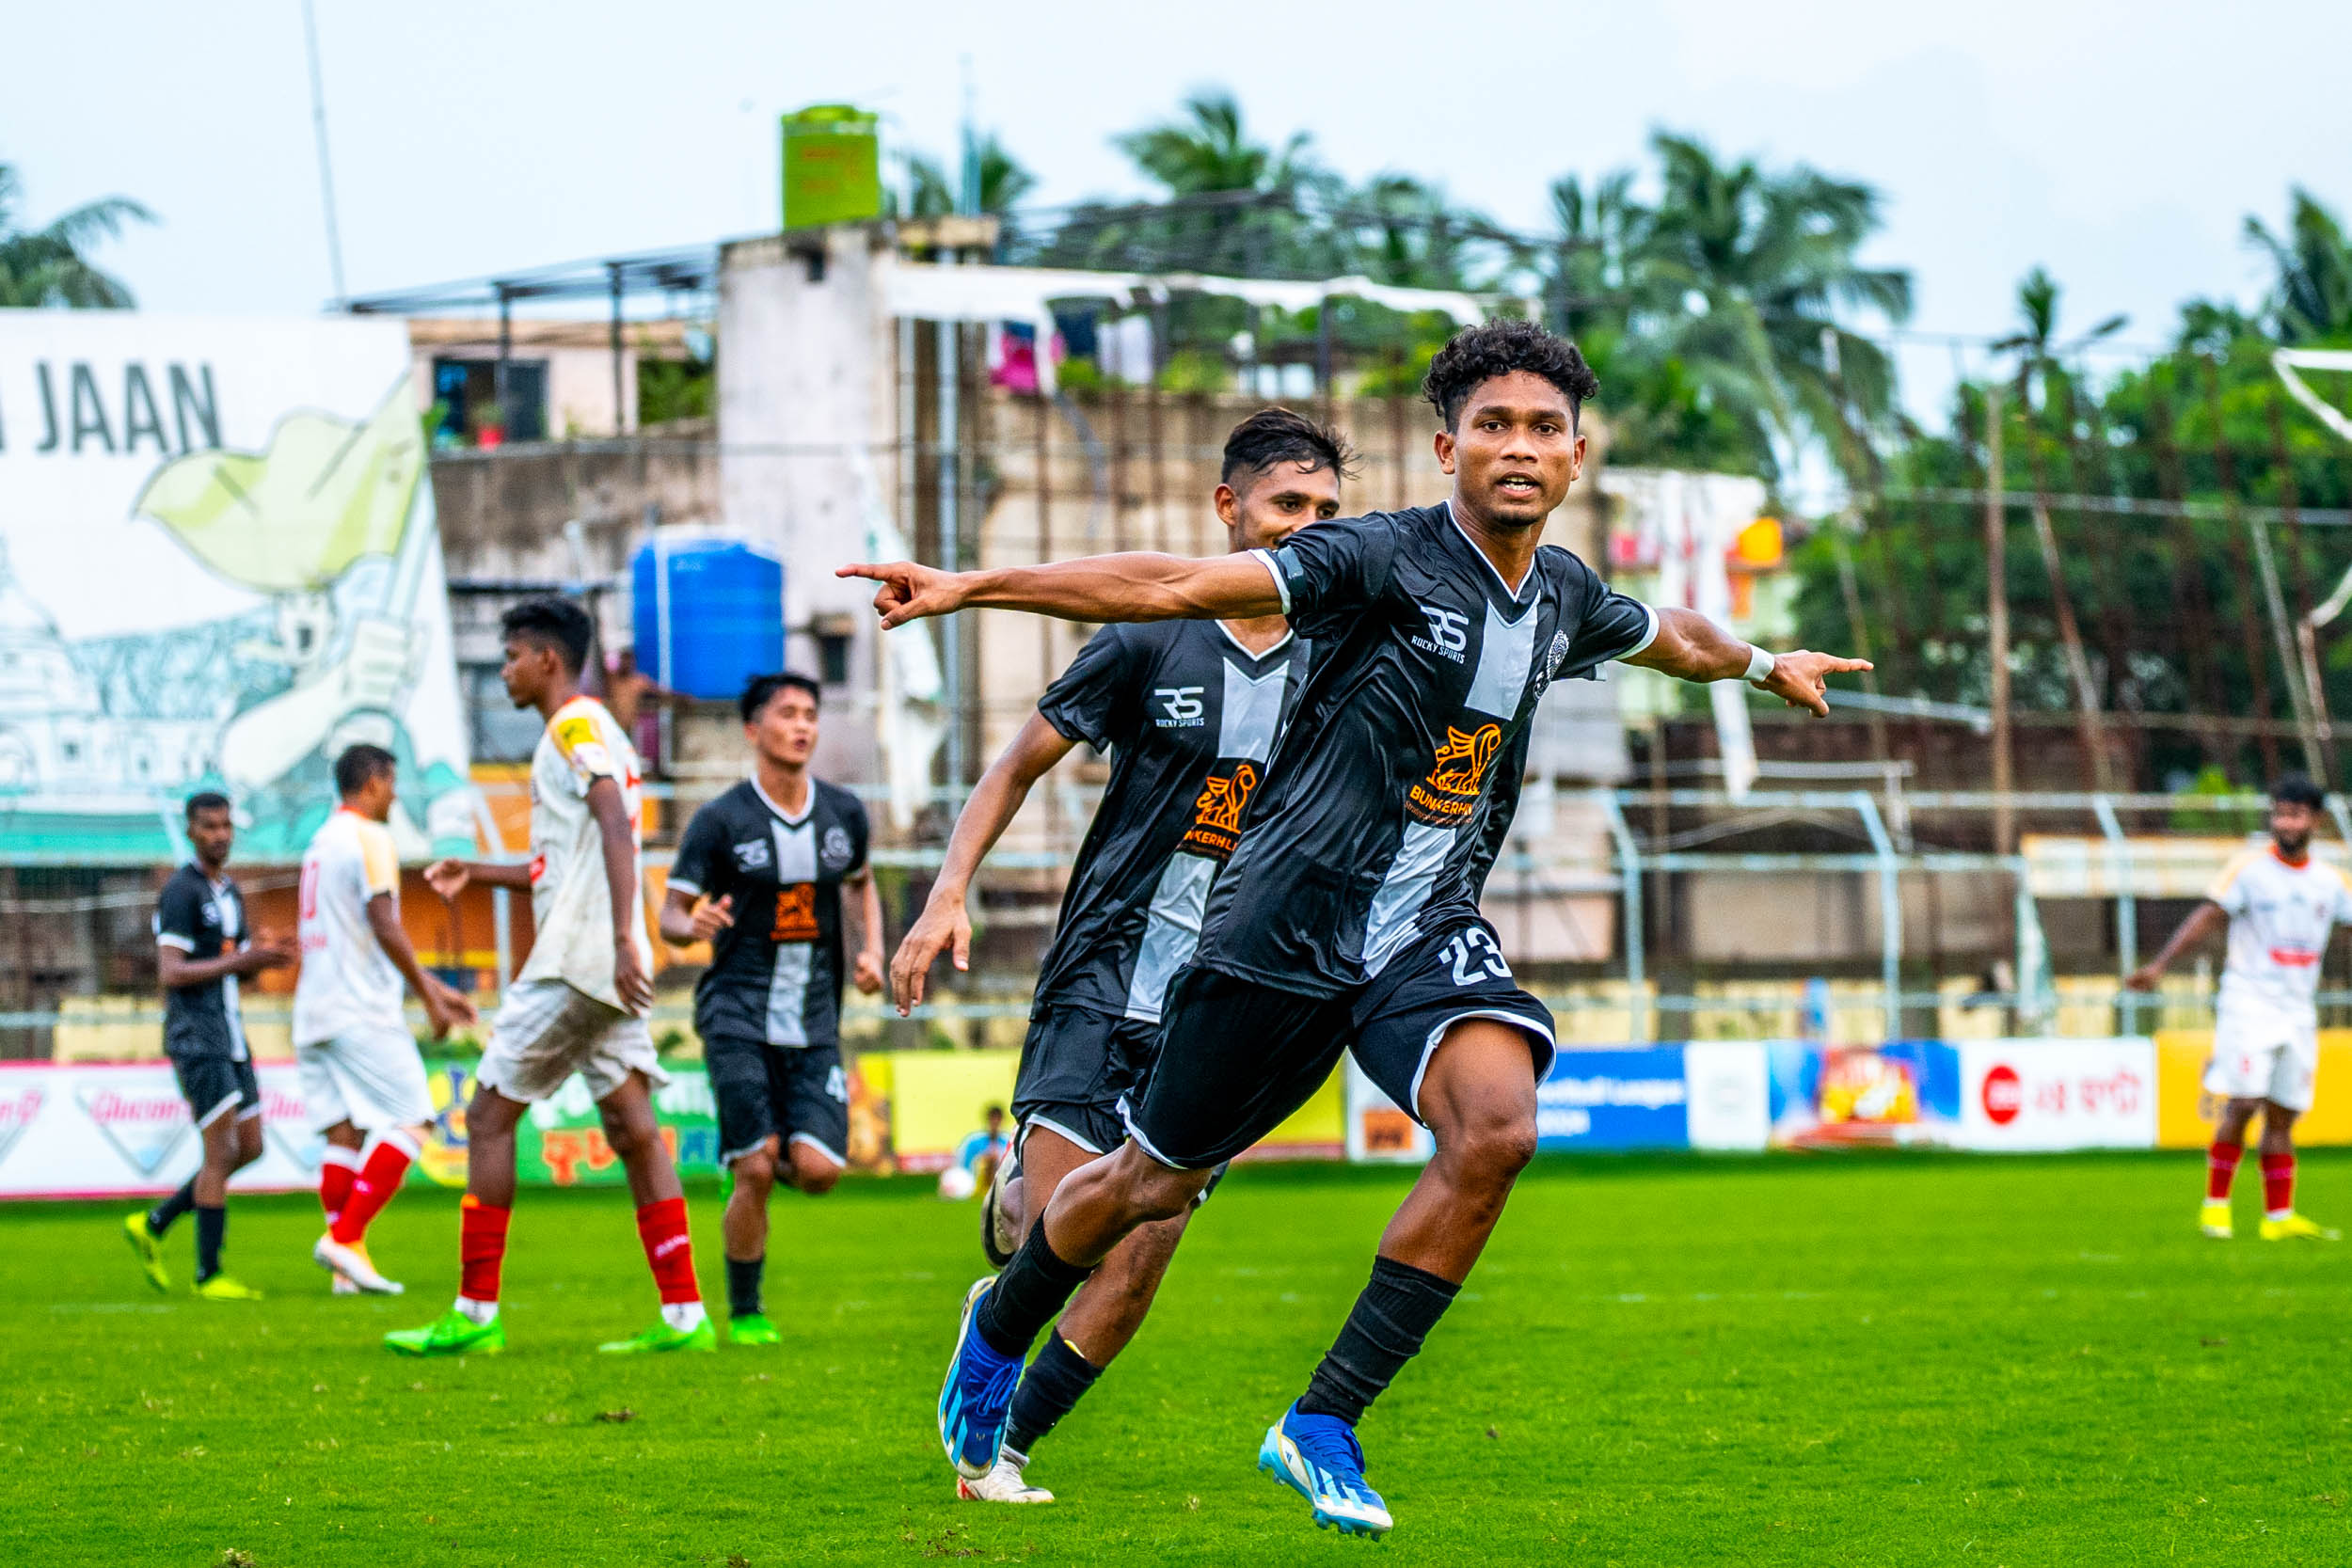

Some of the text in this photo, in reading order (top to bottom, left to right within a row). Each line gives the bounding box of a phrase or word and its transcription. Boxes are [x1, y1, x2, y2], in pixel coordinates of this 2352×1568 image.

[36, 358, 222, 454] JAAN
[1411, 635, 1466, 664] ROCKY SPORTS
[1154, 687, 1204, 720] RS
[1438, 927, 1513, 987] 23
[825, 1065, 849, 1105] 4
